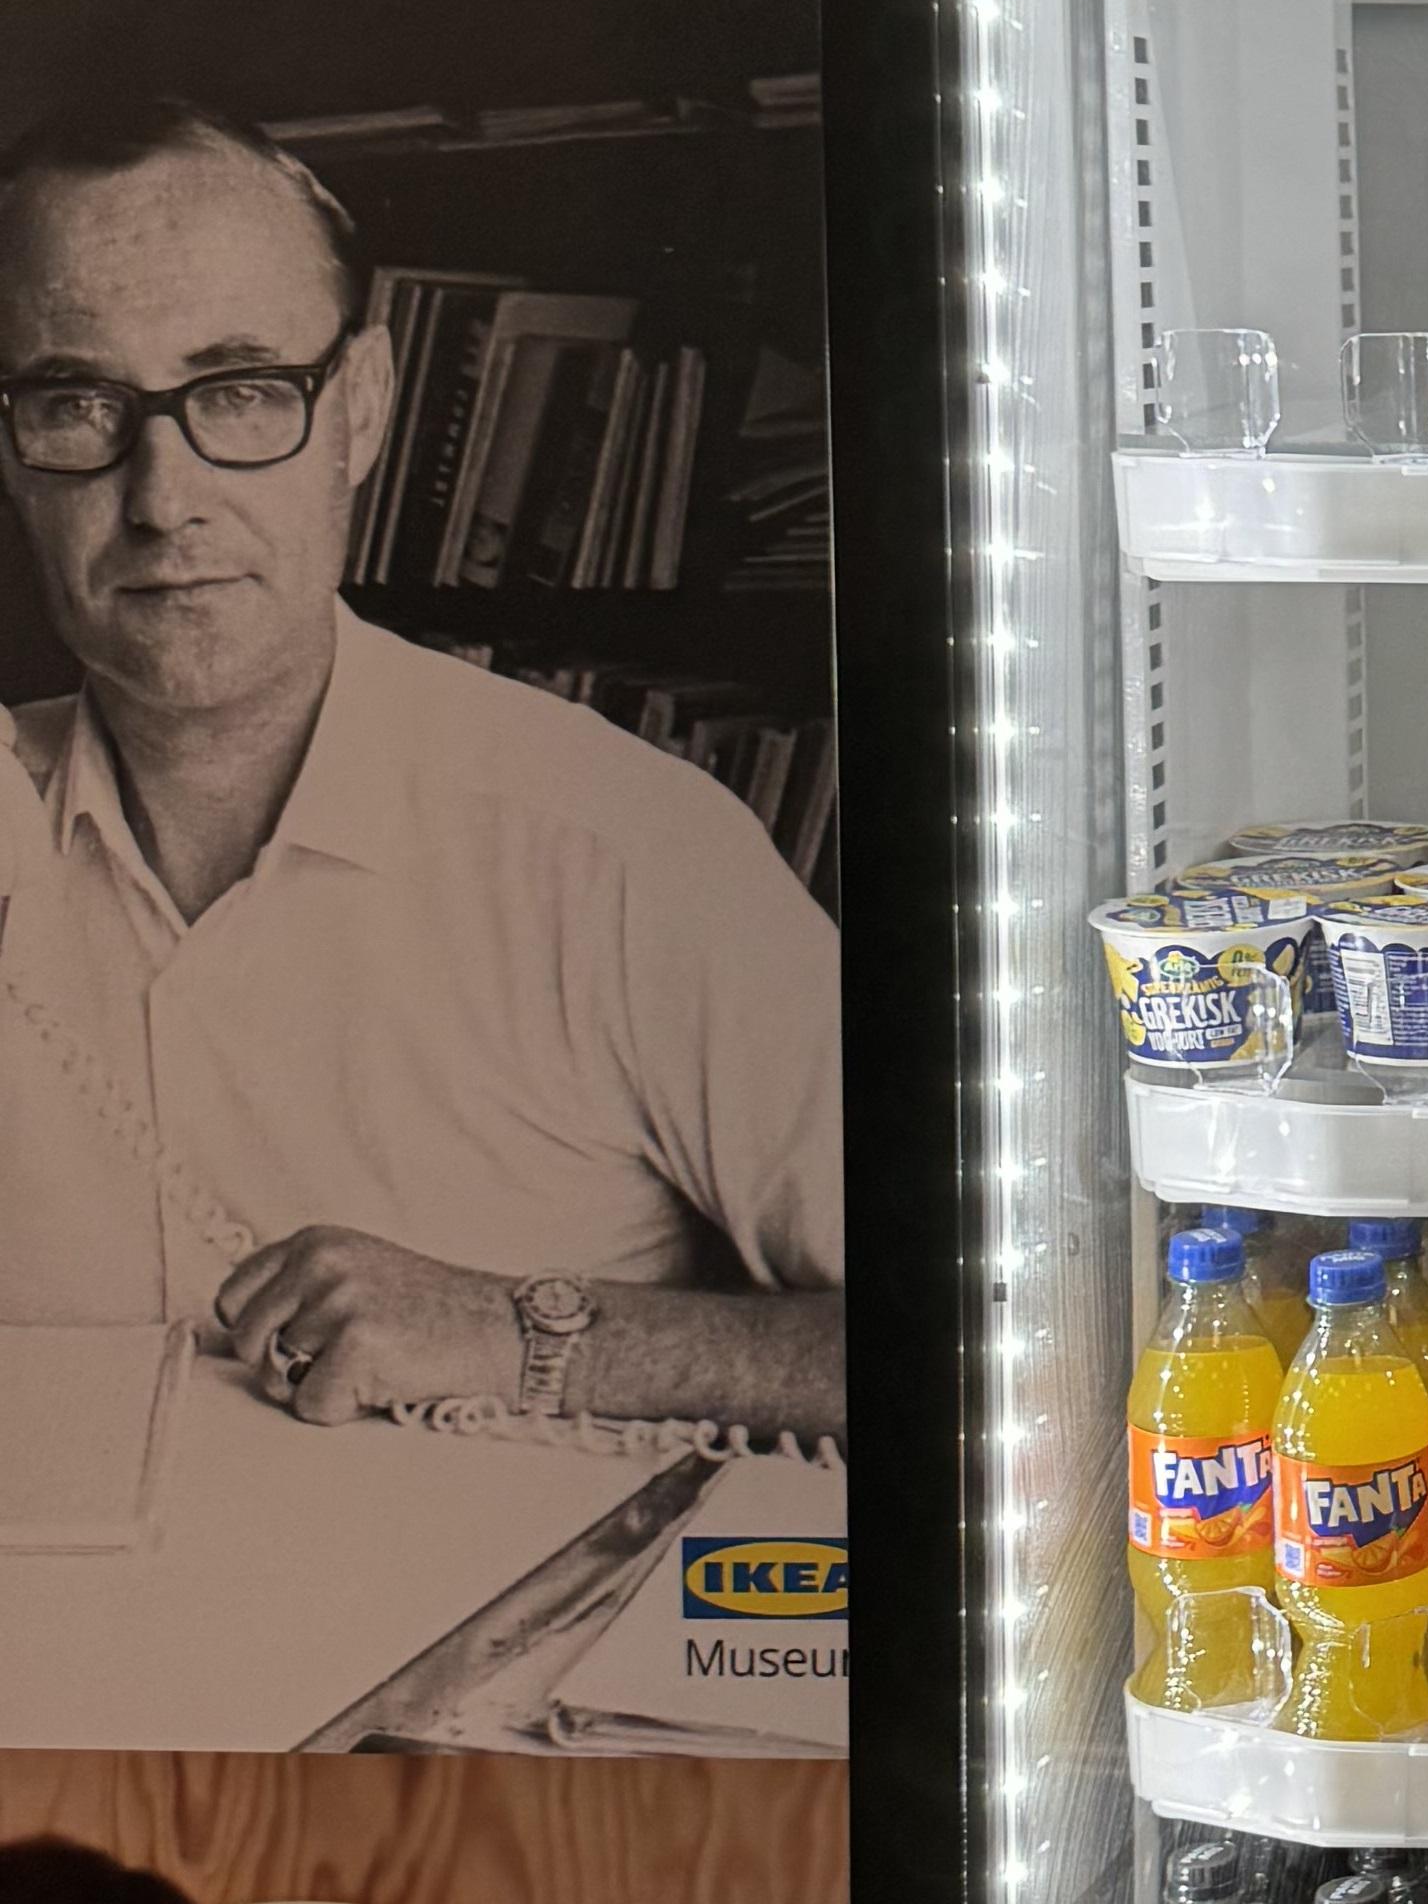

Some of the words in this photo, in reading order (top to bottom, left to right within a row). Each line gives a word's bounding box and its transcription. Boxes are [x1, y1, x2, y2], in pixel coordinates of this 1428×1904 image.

[1138, 990, 1242, 1031] GREKISK
[1306, 1464, 1428, 1528] FANTA
[704, 1561, 848, 1593] IKEA
[686, 1638, 849, 1678] Museu
